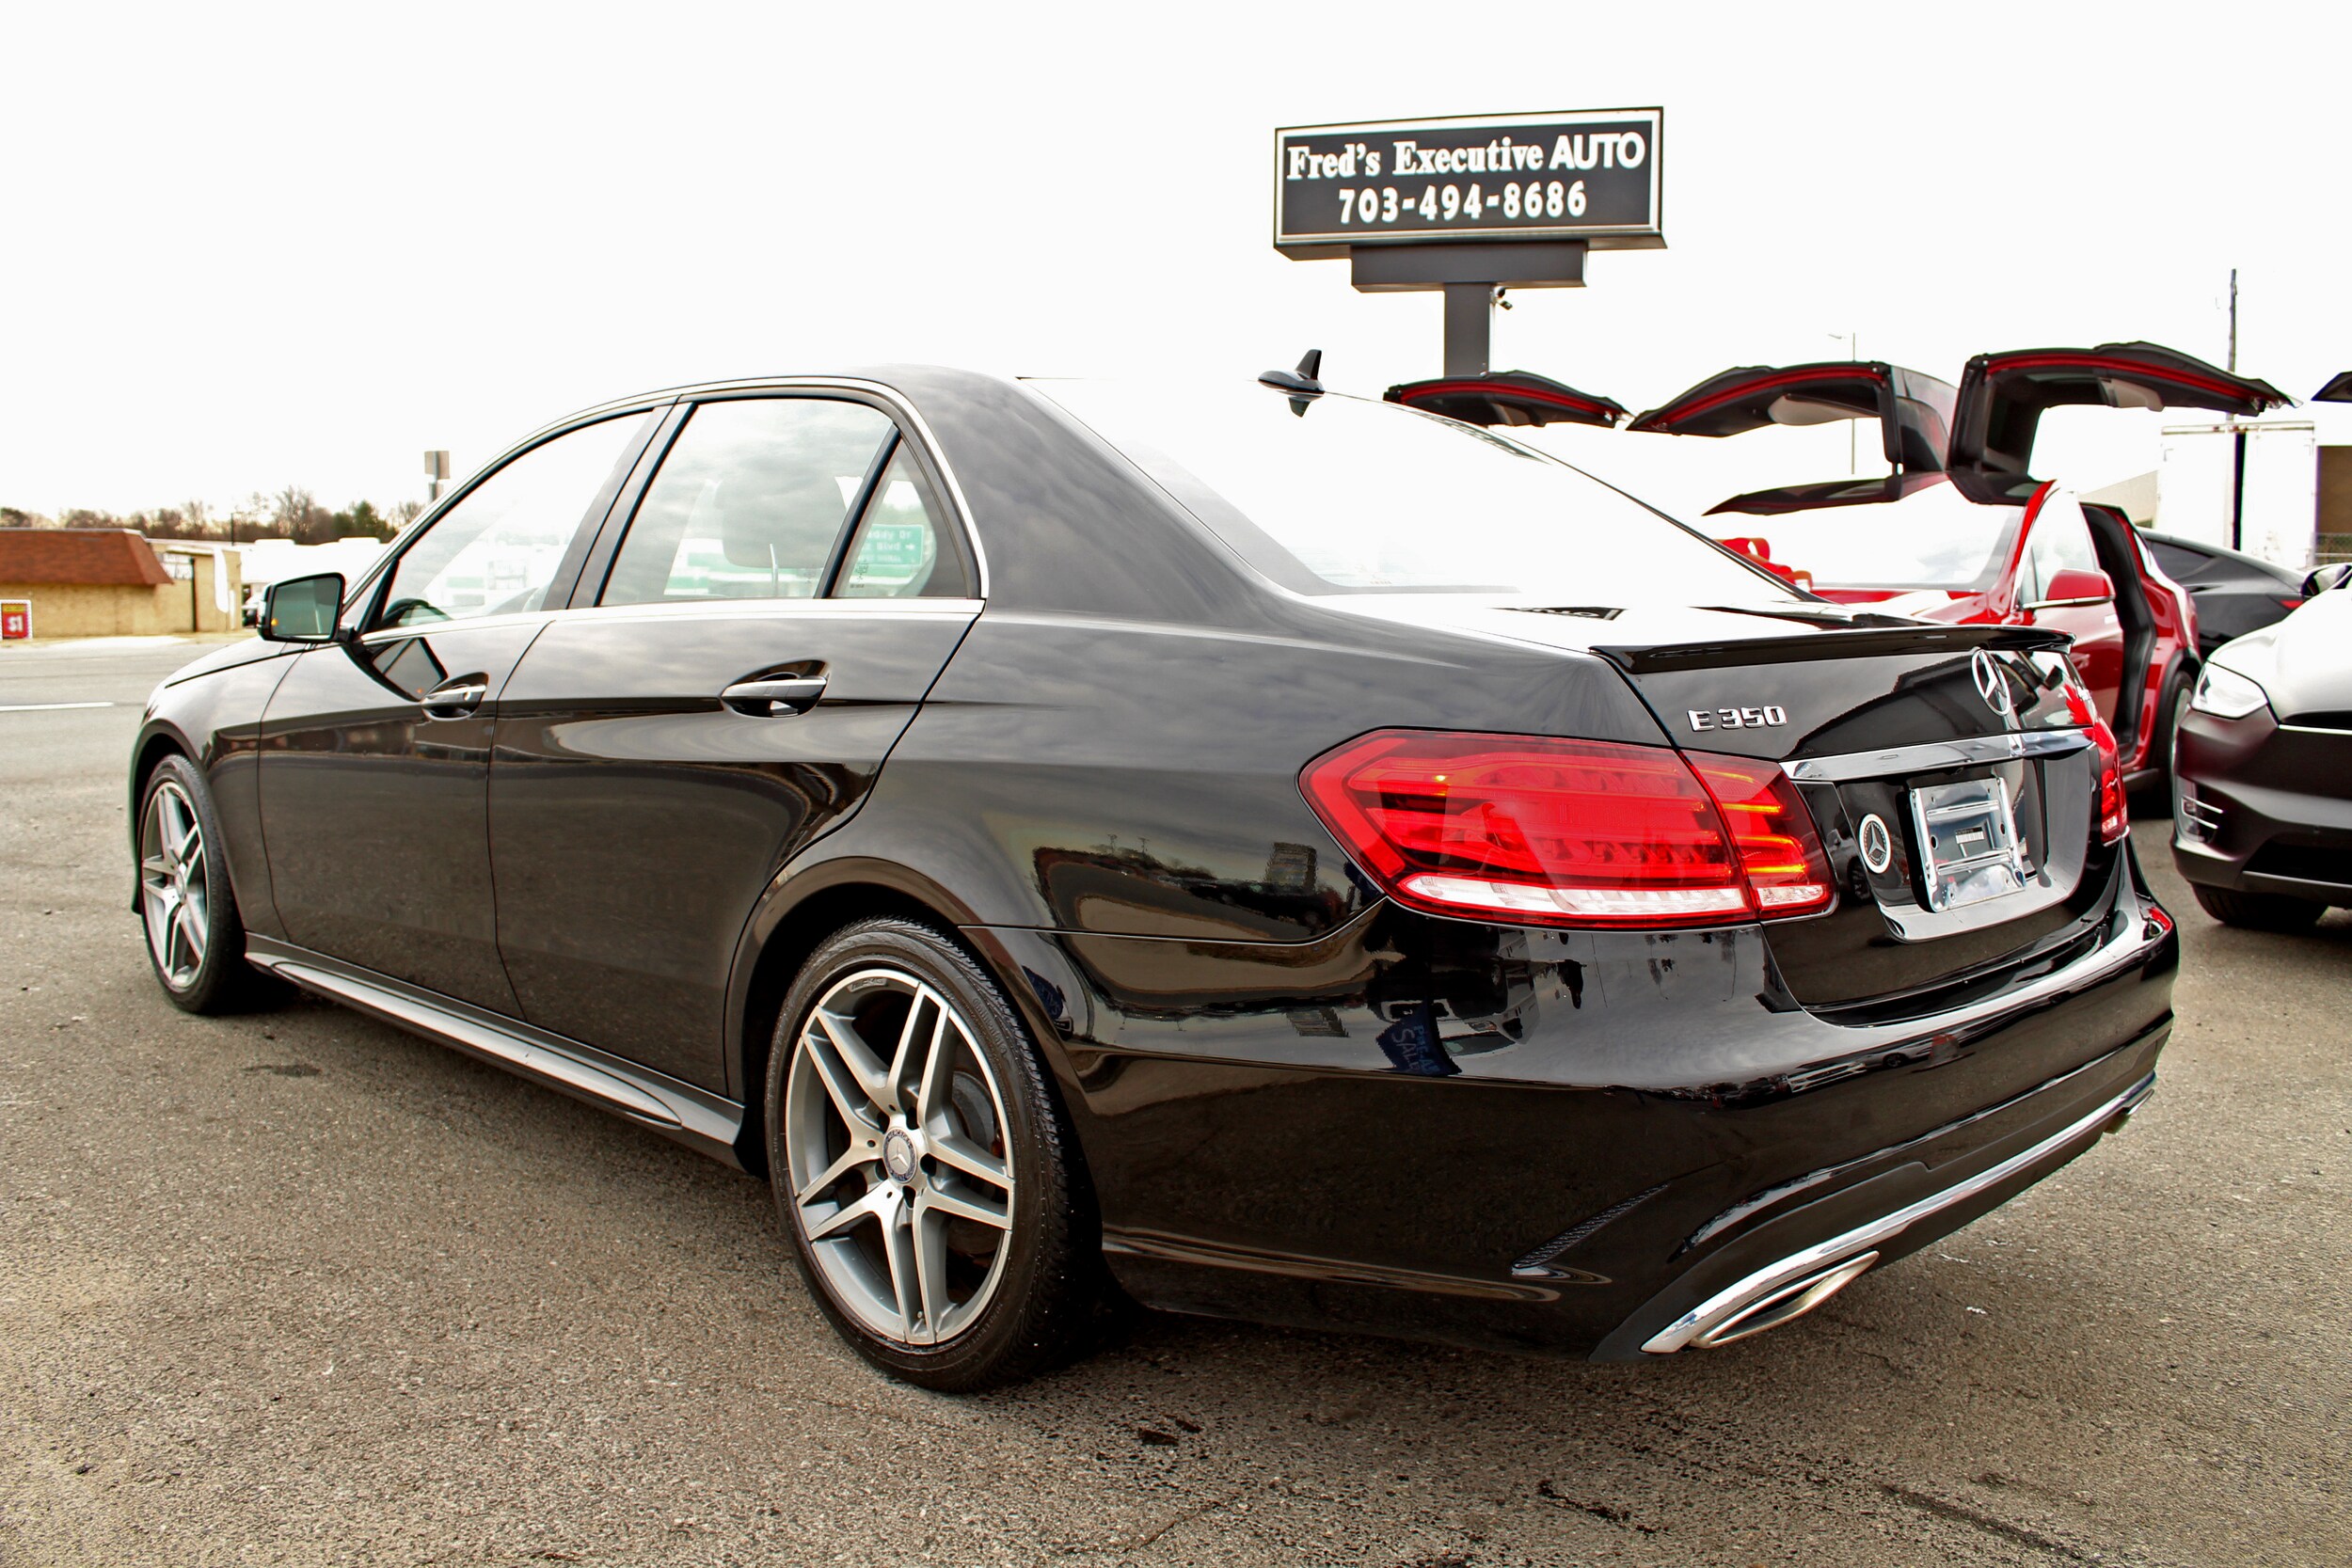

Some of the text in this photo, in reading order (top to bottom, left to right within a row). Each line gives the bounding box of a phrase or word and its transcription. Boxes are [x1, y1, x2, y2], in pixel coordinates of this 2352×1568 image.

[1286, 131, 1646, 180] Fred's Executive AUTO
[1338, 179, 1588, 224] 703-494-8686
[1687, 705, 1788, 732] E 350
